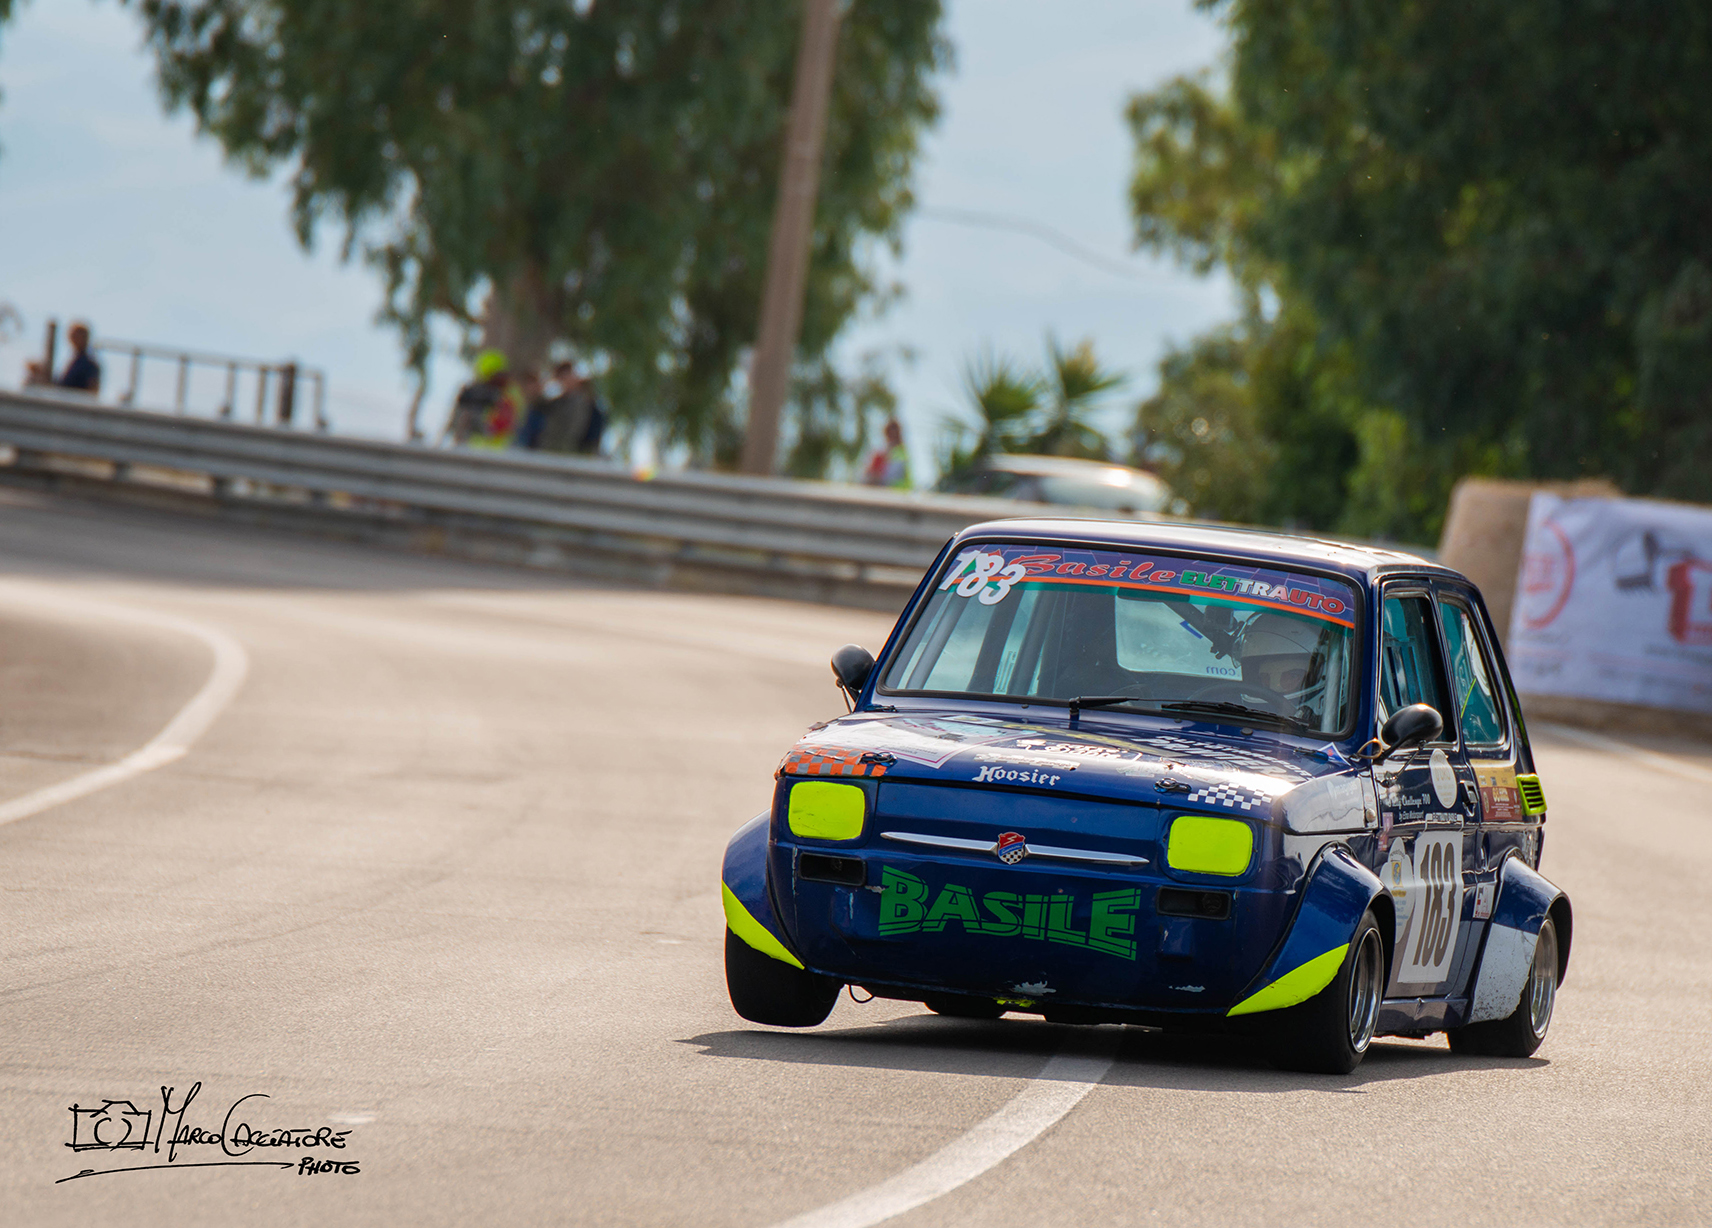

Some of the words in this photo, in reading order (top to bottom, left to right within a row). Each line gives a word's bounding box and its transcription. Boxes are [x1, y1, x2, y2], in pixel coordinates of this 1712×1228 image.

[938, 549, 1026, 606] 183
[1008, 553, 1177, 583] Basile
[1179, 570, 1346, 615] ELETTRAUTO
[971, 765, 1061, 787] Hoosier
[877, 864, 1142, 962] BASILE
[1411, 841, 1458, 968] 183
